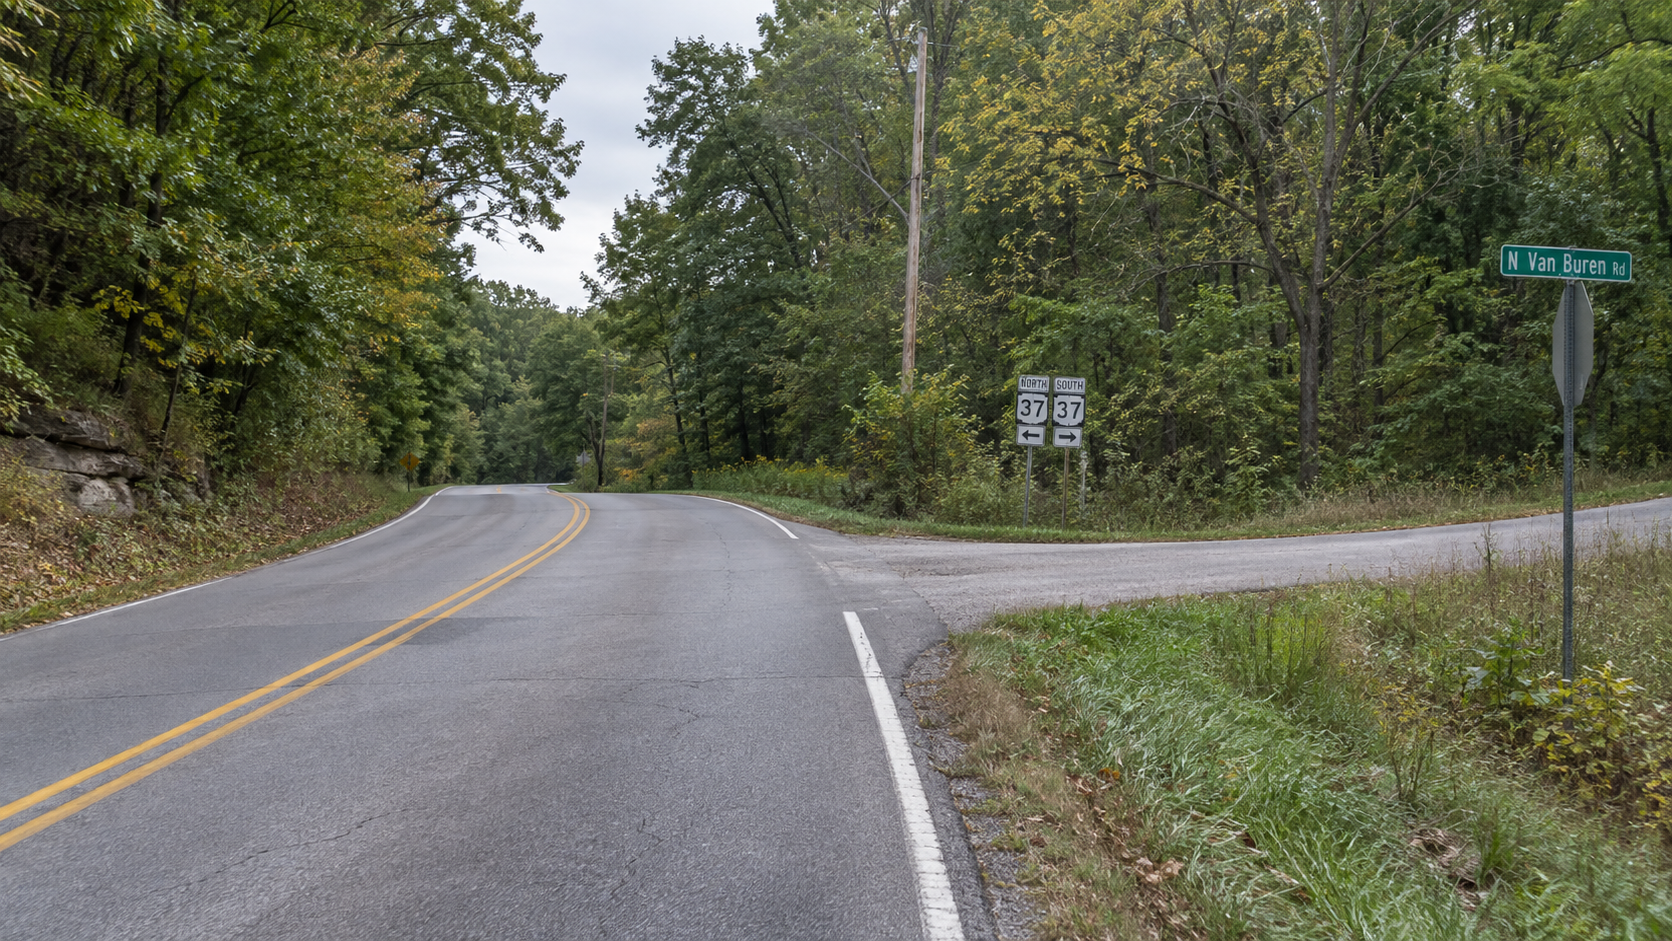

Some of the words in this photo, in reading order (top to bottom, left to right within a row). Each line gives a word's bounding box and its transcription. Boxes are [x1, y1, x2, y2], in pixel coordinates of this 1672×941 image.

[1508, 250, 1518, 271] N
[1528, 252, 1556, 272] Van
[1563, 253, 1606, 275] Buren
[1612, 262, 1626, 276] Rd
[1021, 377, 1047, 388] NORTH
[1056, 379, 1084, 390] SOUTH
[1020, 399, 1045, 418] 37
[1056, 401, 1082, 419] 37
